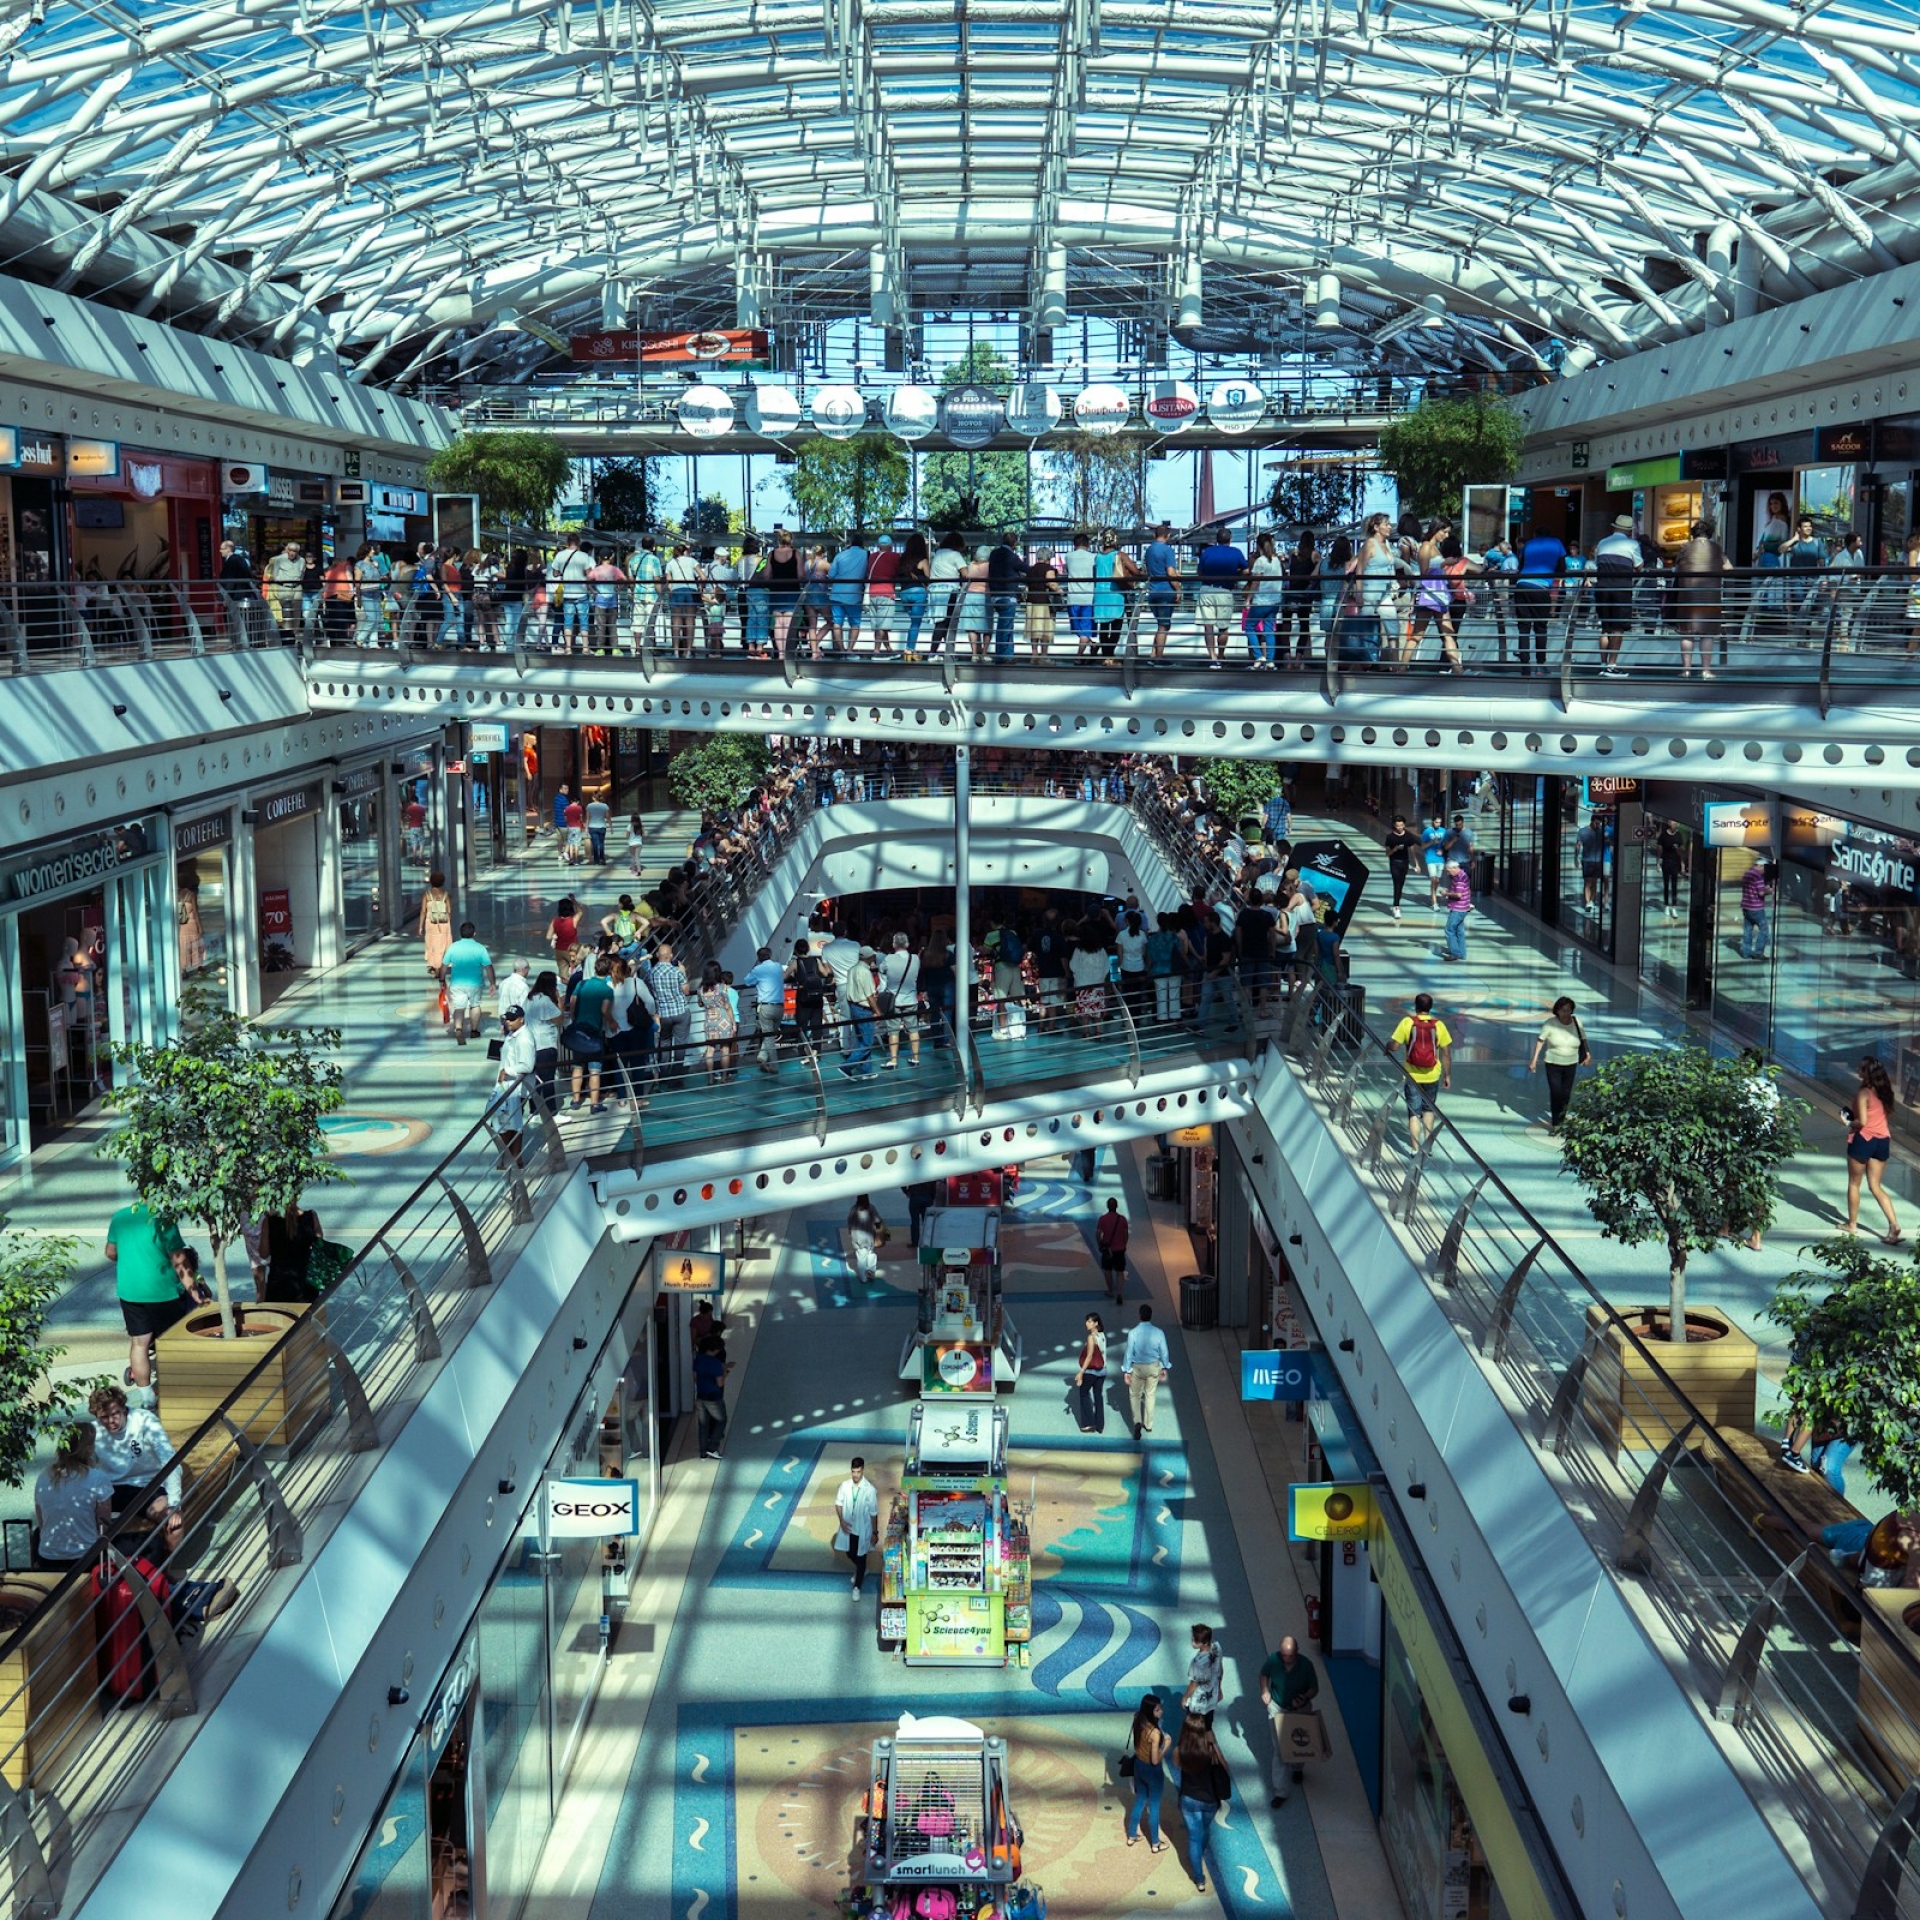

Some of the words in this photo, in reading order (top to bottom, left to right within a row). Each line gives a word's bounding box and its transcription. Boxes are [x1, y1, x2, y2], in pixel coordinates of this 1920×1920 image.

[1075, 404, 1129, 416] Chopperia
[1150, 402, 1194, 413] LUSITANA
[266, 791, 307, 821] CORTEFIEL
[1712, 818, 1770, 829] Samsonite
[176, 817, 226, 851] CORTEFIEL
[15, 843, 120, 898] women'secret
[1831, 838, 1915, 892] Samsonite
[683, 1281, 712, 1290] Puppies
[1252, 1368, 1302, 1386] MEO
[553, 1501, 632, 1517] GEOX
[1314, 1524, 1362, 1536] CELEIRO
[932, 1625, 992, 1637] Science4you
[896, 1863, 966, 1876] smartlunch
